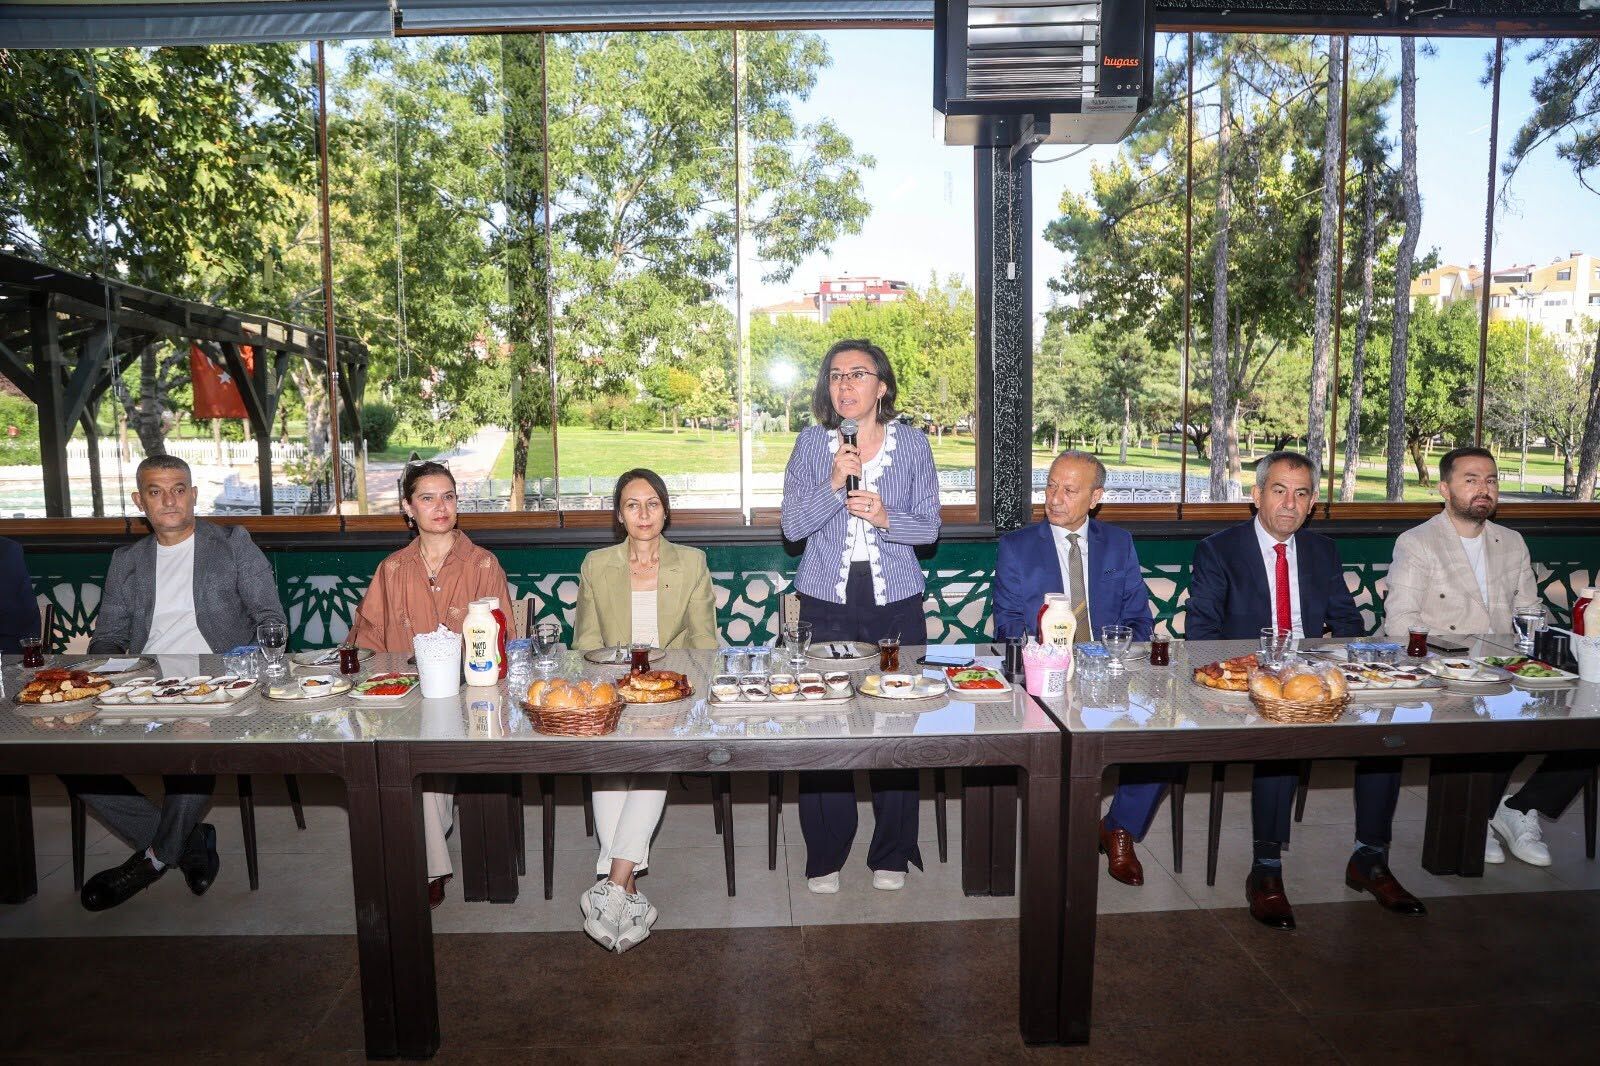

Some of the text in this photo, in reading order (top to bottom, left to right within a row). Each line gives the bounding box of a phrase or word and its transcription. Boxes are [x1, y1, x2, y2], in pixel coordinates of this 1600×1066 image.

[1103, 56, 1139, 68] bugass
[472, 642, 487, 650] MAYO
[475, 650, 485, 658] NEZ
